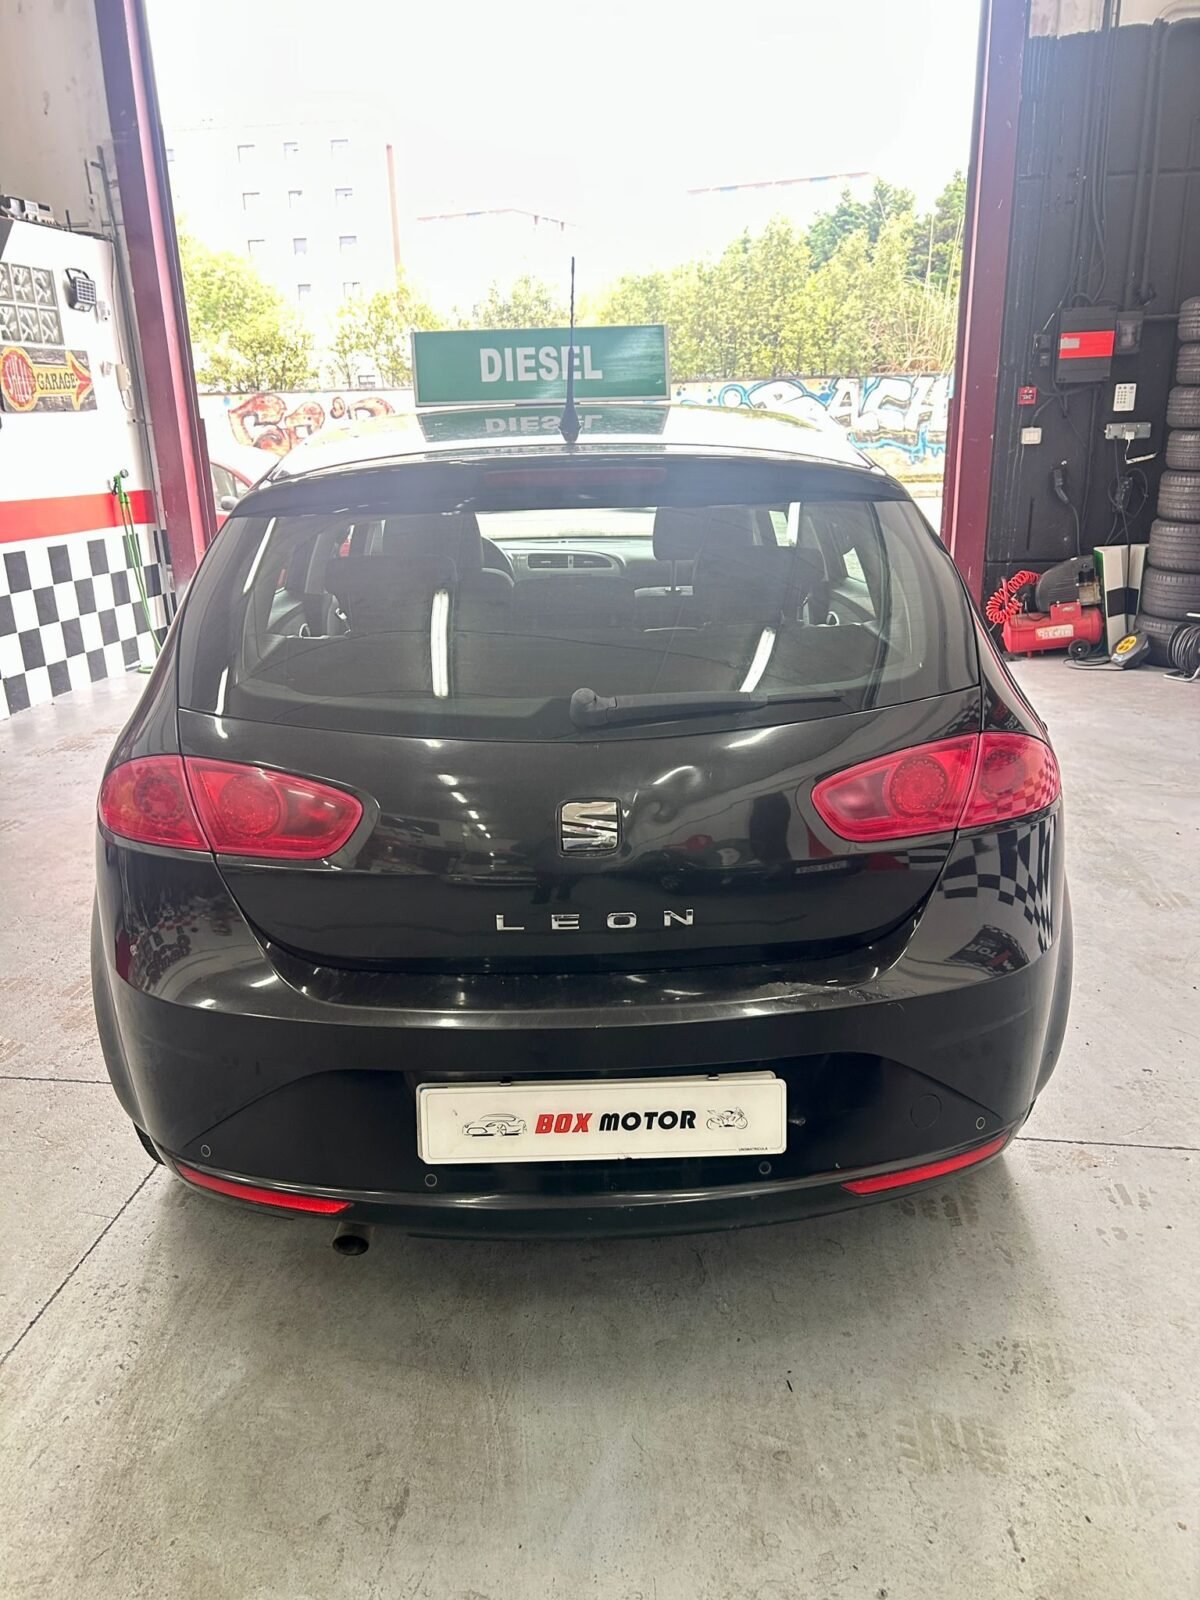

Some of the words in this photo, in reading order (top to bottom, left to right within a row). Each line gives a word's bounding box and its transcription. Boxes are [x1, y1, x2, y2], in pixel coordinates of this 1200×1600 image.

[480, 345, 603, 383] DIESEL
[37, 372, 77, 391] GARAGE
[496, 908, 694, 931] LEON
[535, 1112, 593, 1134] BOX
[599, 1110, 697, 1132] MOTOR
